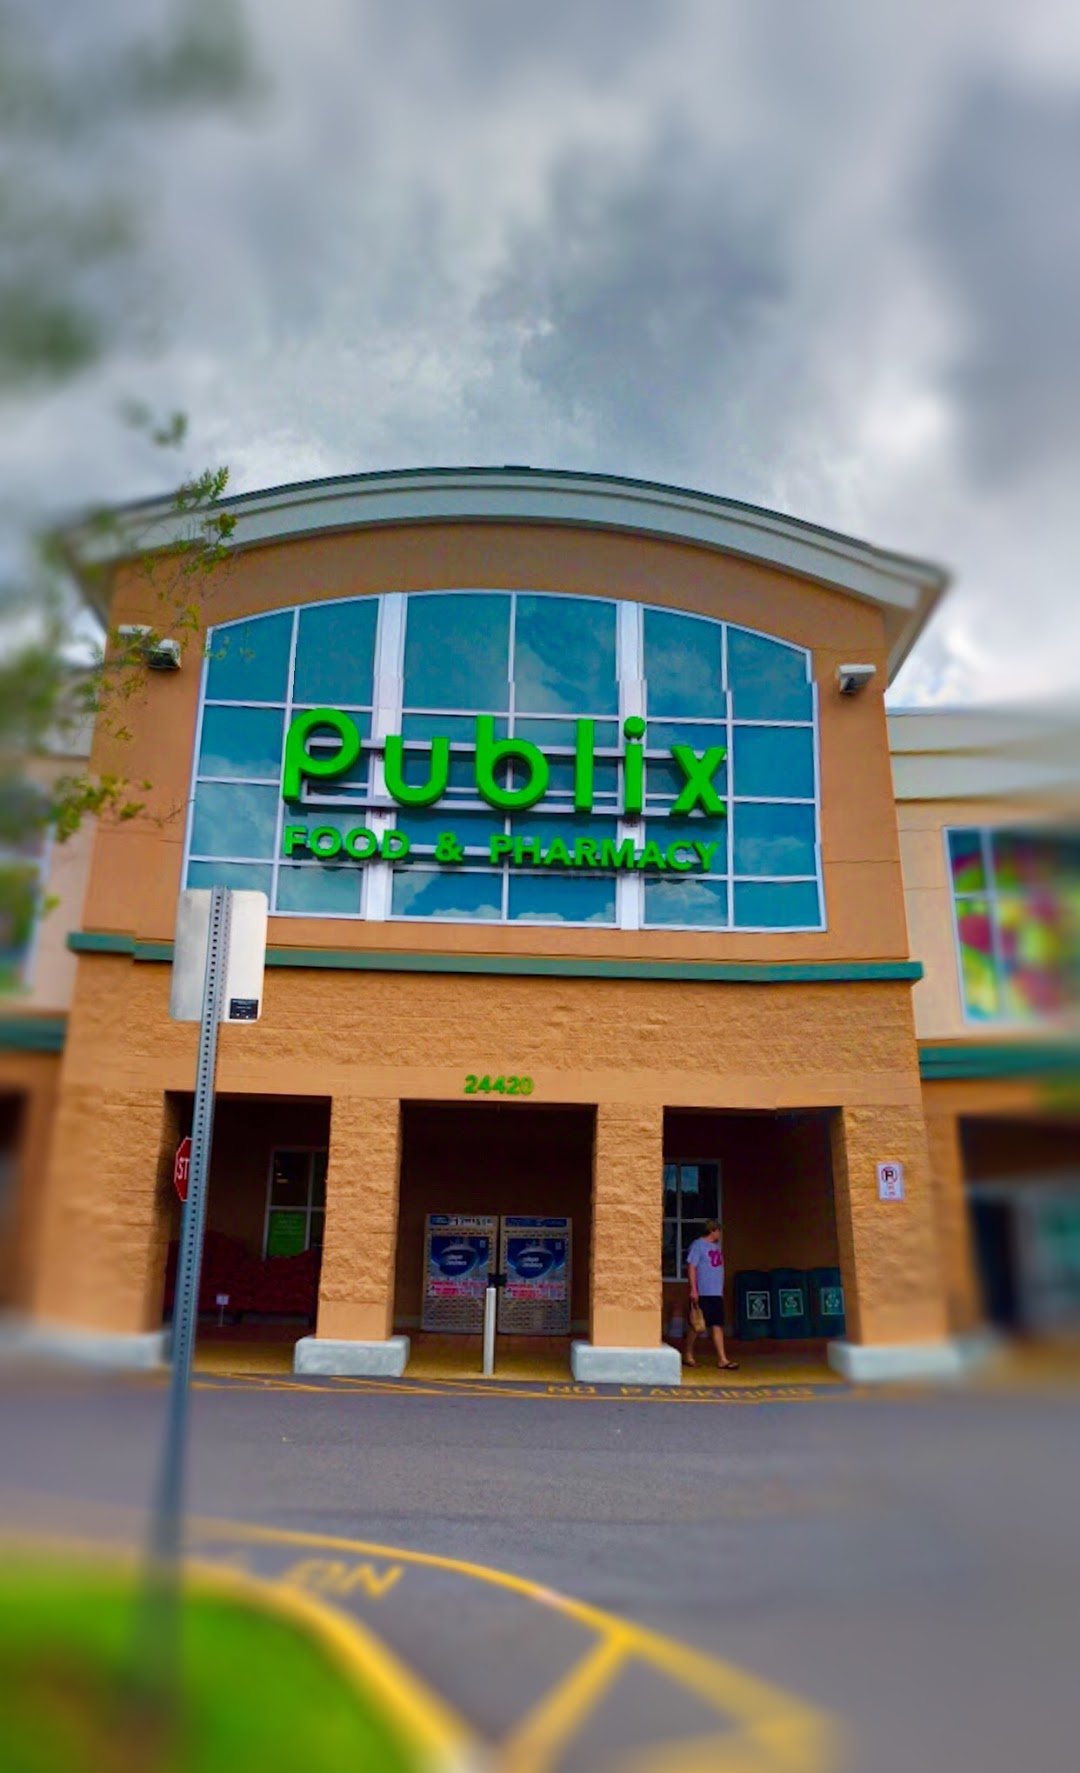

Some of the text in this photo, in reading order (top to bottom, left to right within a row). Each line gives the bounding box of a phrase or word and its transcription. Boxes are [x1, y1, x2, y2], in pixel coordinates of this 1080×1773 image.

[282, 707, 728, 817] Publix
[284, 825, 720, 872] FOOD & PHARMACY
[464, 1074, 534, 1096] 24420
[176, 1157, 190, 1180] ST
